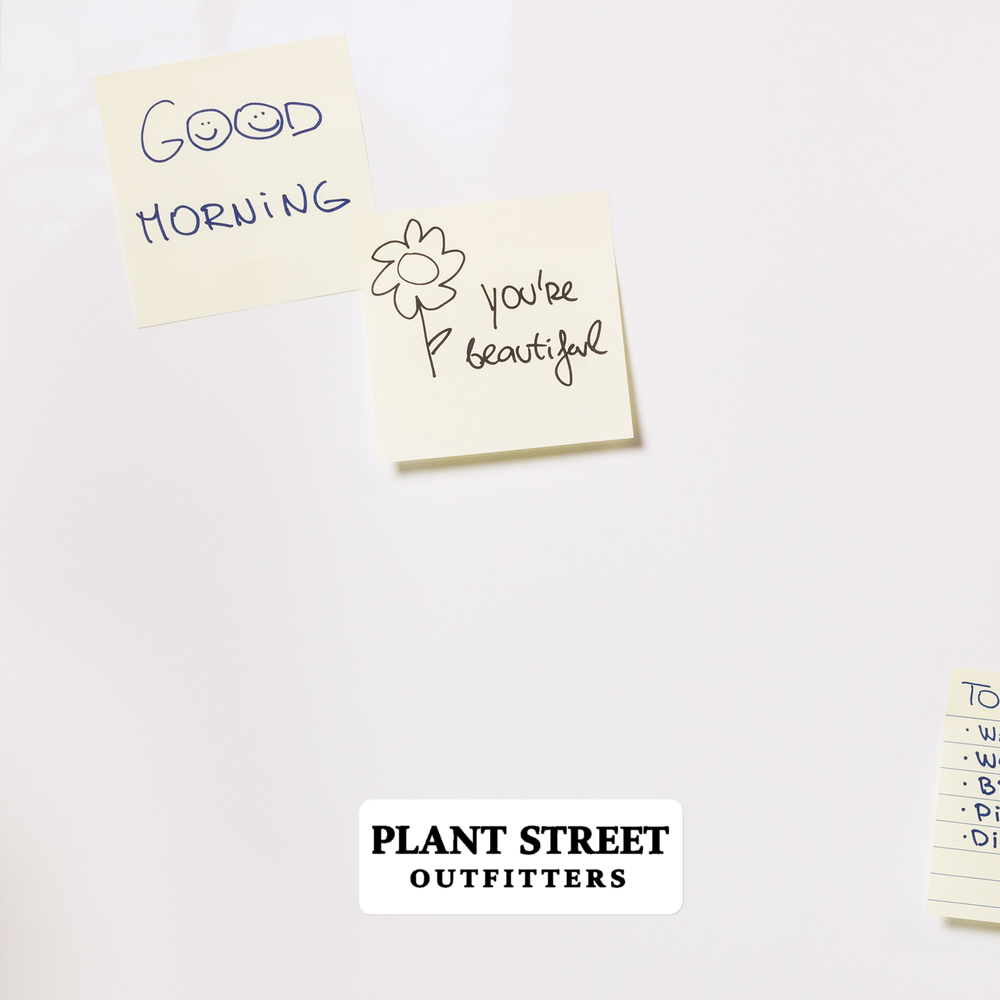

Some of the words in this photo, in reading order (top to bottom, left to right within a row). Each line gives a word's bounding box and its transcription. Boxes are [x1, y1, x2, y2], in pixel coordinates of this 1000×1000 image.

[140, 99, 323, 163] GOOD
[465, 318, 608, 387] beautiful
[961, 681, 1000, 709] TO
[371, 825, 507, 855] PLANT
[519, 825, 670, 856] STREET
[409, 868, 626, 889] OUTFITTERS
